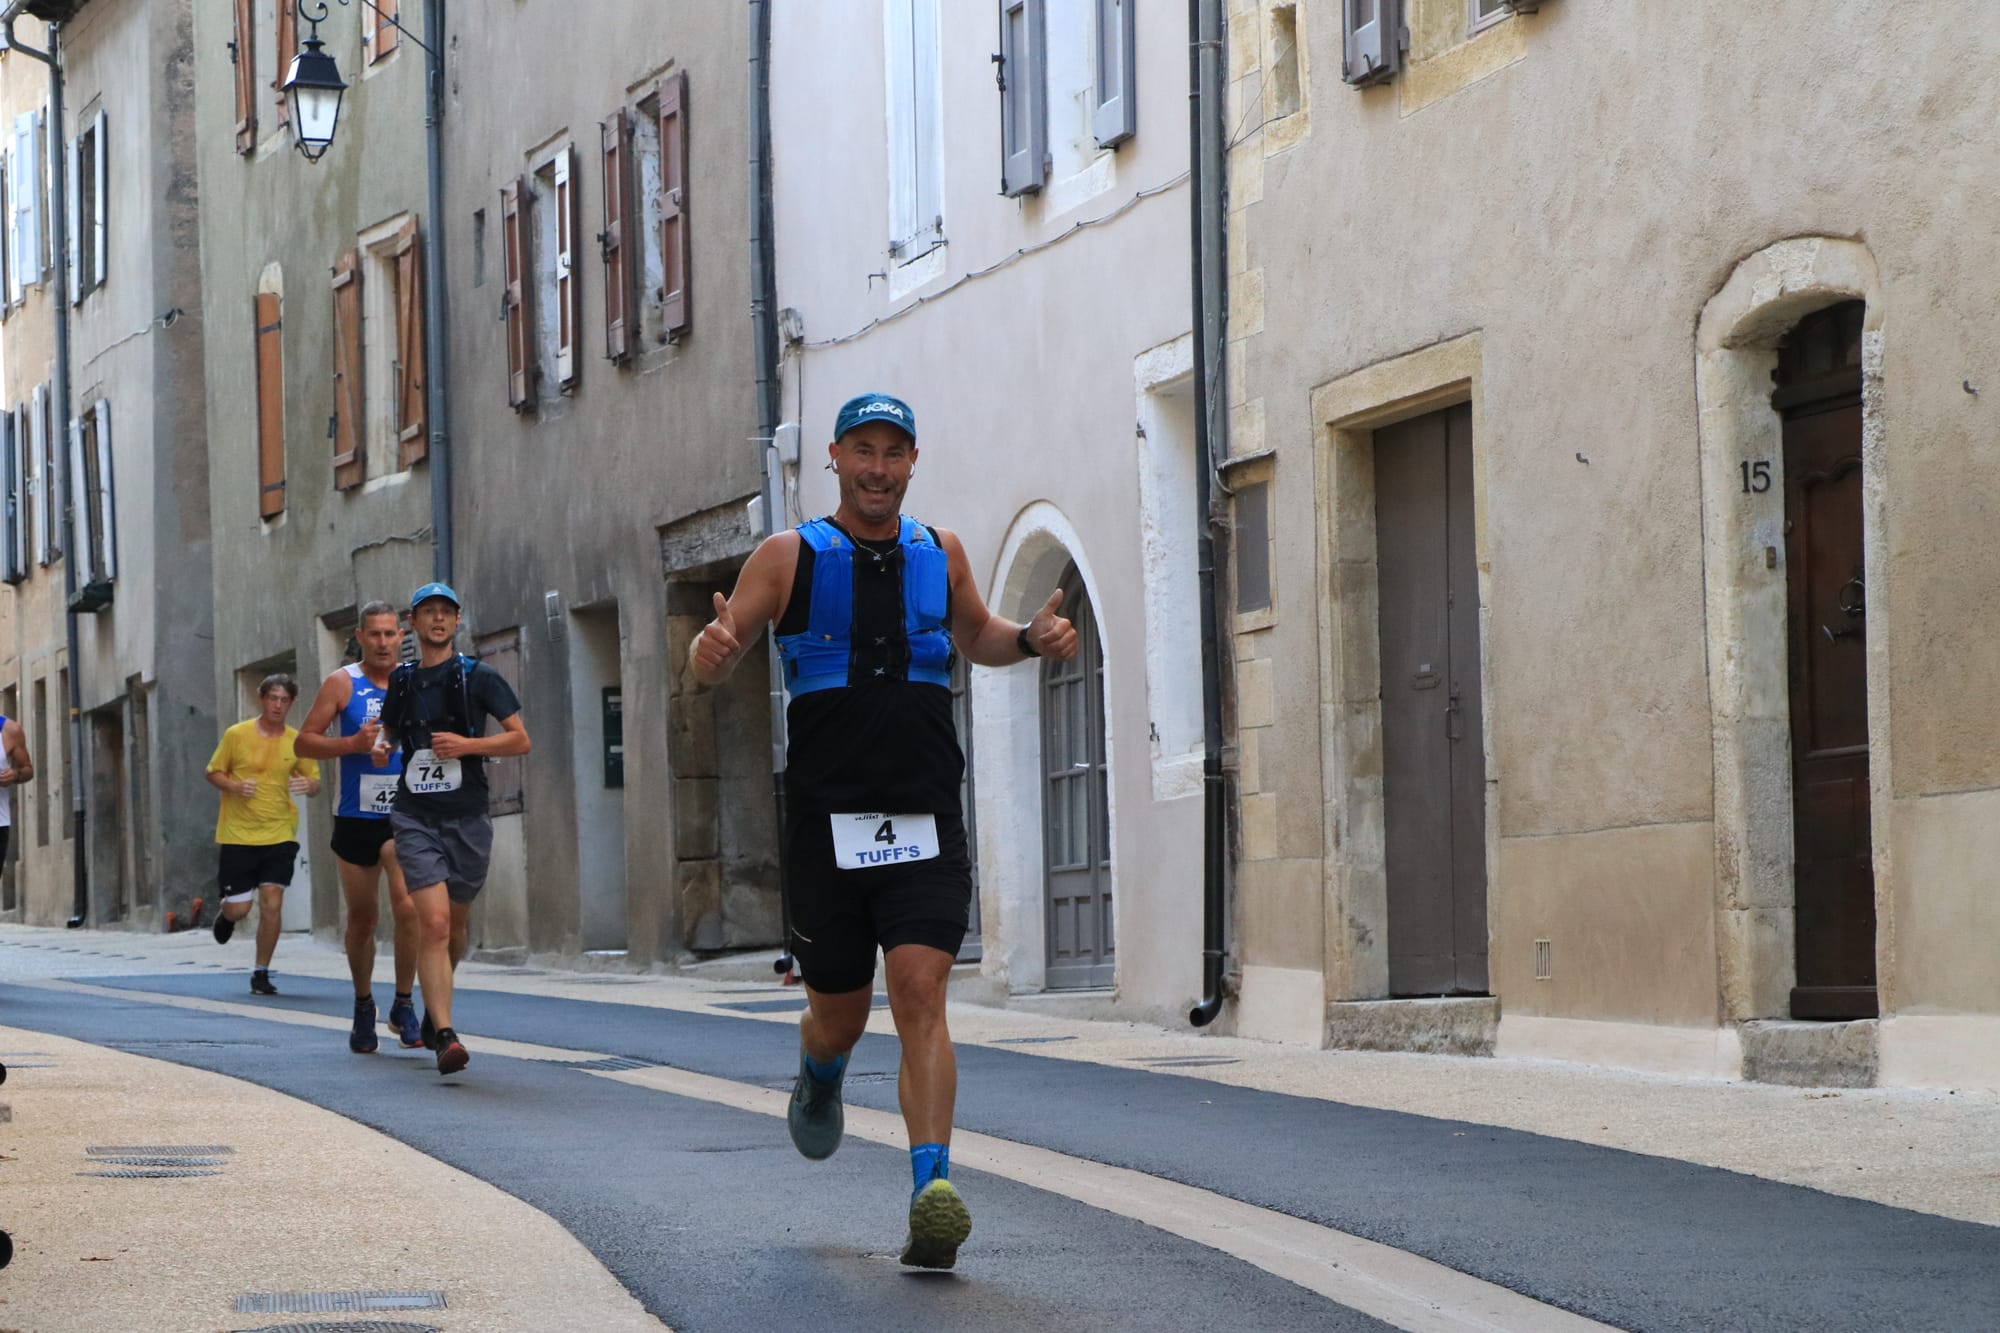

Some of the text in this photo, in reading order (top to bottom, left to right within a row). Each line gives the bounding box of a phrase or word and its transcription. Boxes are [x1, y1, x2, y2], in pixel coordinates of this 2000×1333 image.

[858, 402, 903, 419] HOKA
[1740, 460, 1771, 493] 15
[418, 765, 445, 781] 74
[413, 782, 452, 791] TUFF'S
[370, 804, 391, 812] TUF
[874, 819, 897, 845] 4
[855, 845, 921, 864] TUFF'S
